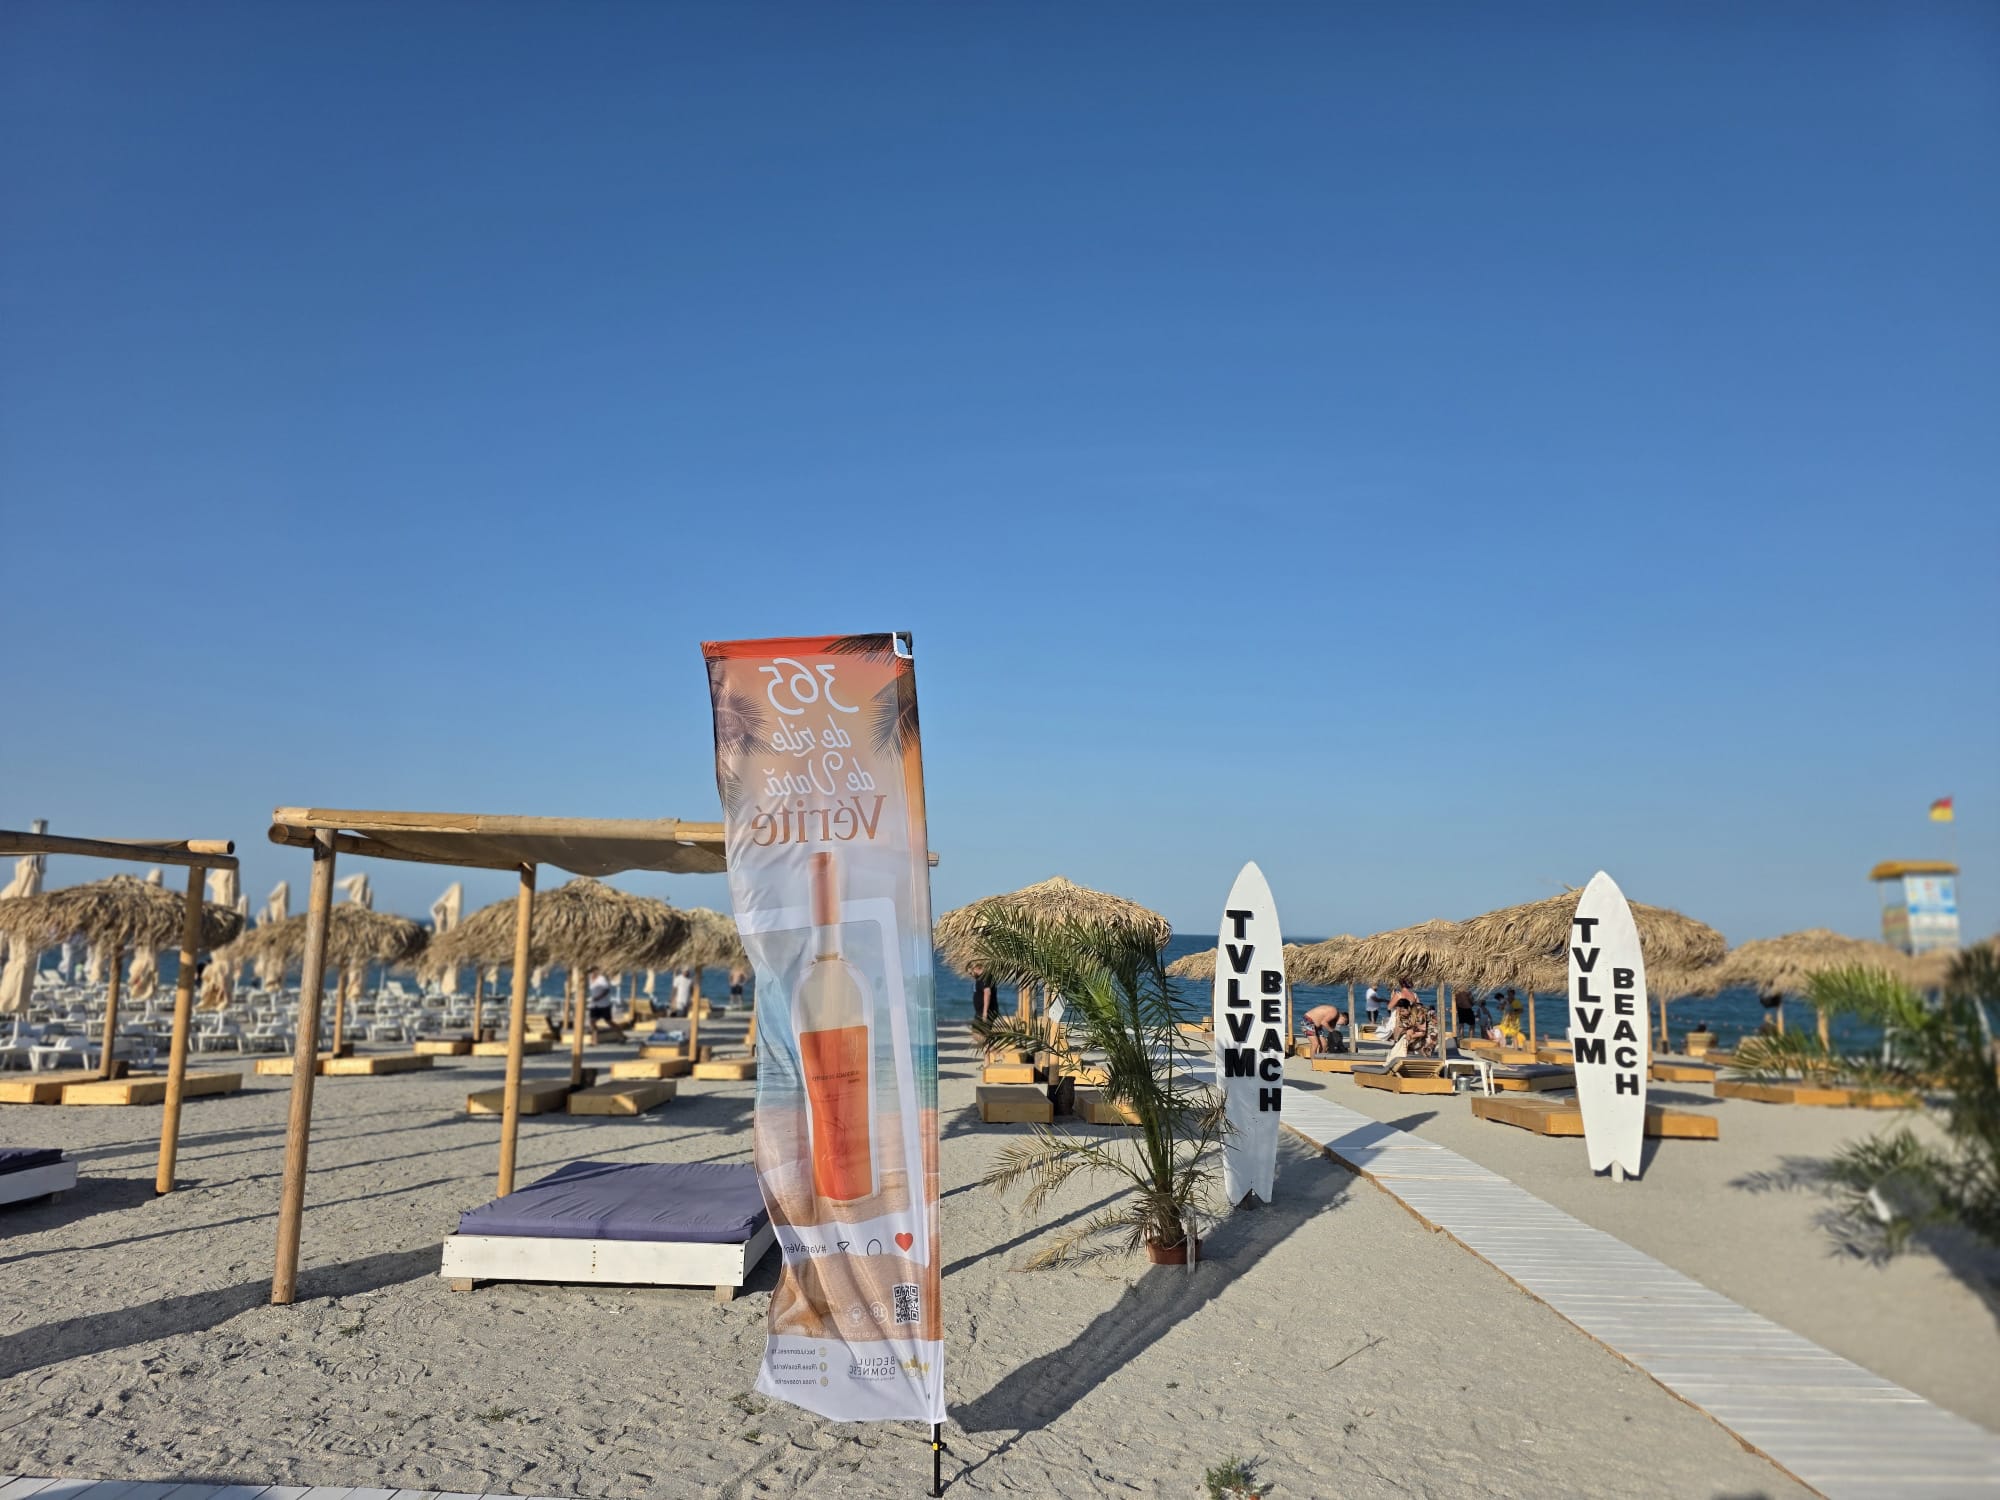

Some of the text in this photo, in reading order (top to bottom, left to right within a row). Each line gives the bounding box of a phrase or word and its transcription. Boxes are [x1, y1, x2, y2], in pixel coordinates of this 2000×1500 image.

[1224, 909, 1256, 1077] TVLVM
[1259, 970, 1283, 1112] BEACH
[1572, 917, 1606, 1065] TVLVM
[1612, 967, 1639, 1096] BEACH
